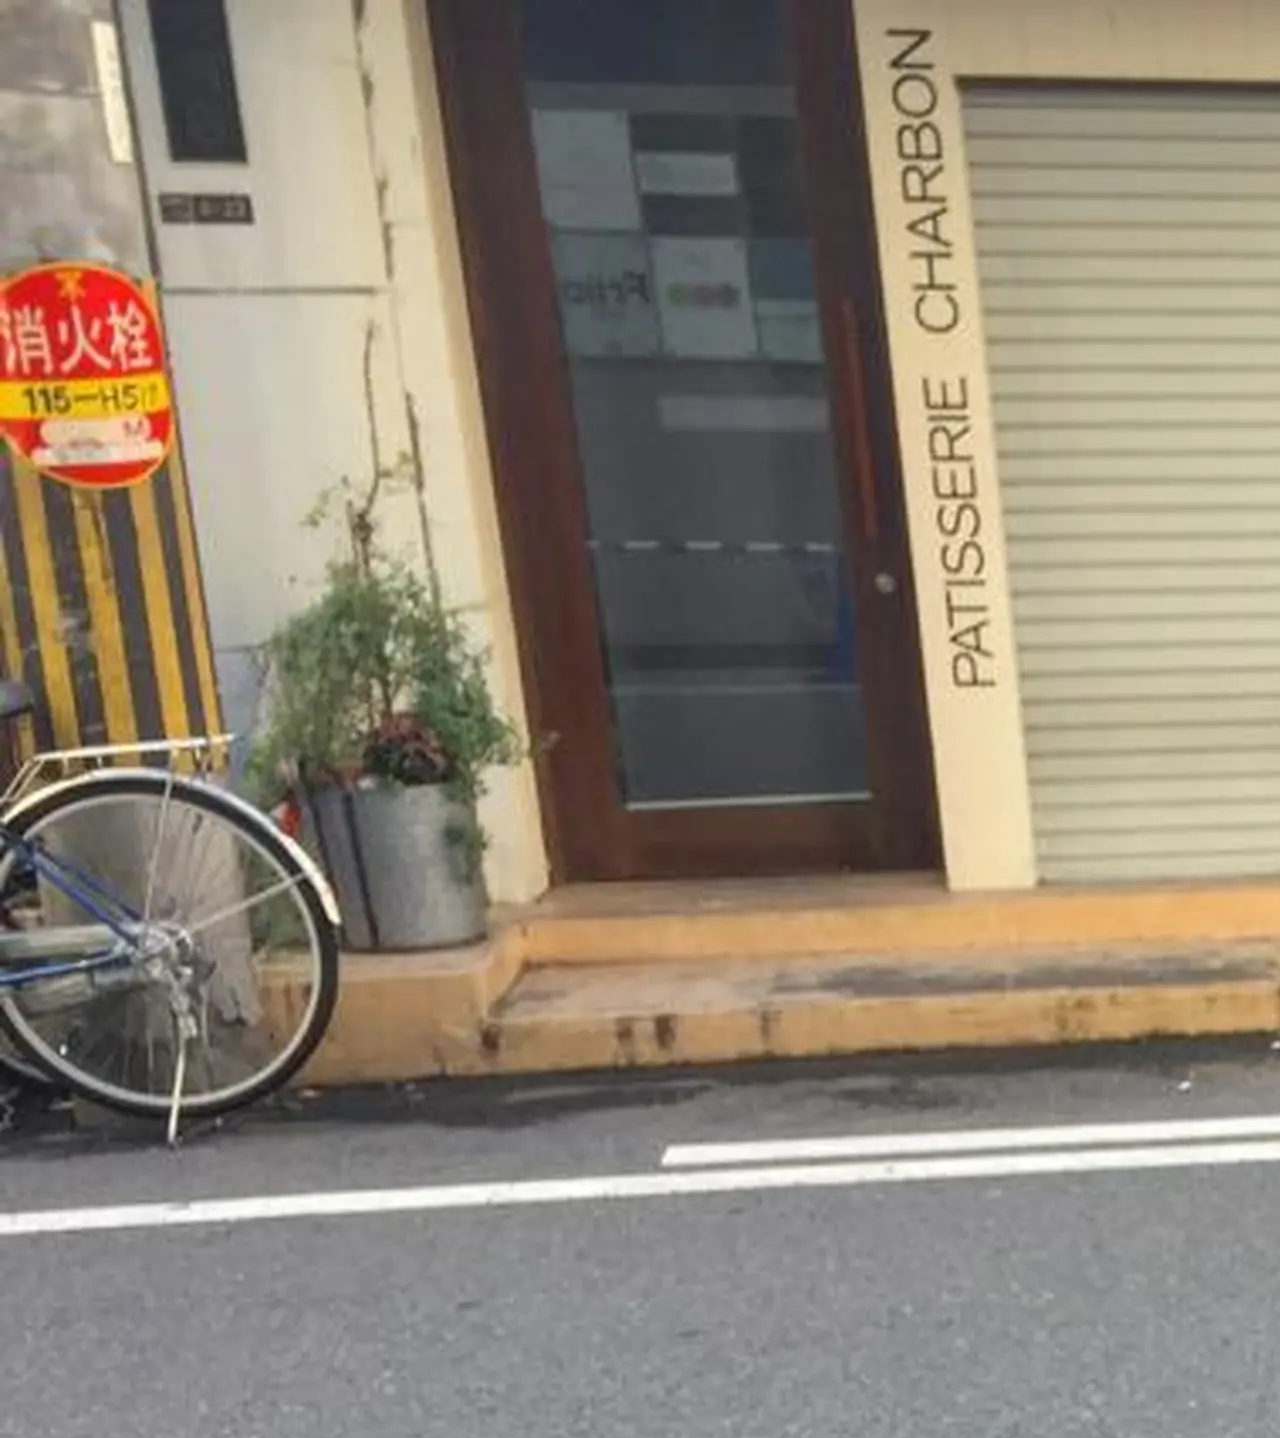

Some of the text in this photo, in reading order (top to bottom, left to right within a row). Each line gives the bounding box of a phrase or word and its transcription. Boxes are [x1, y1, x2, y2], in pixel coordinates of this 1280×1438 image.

[0, 299, 154, 375] 消火栓
[885, 27, 997, 689] PATISSERIE CHARBON
